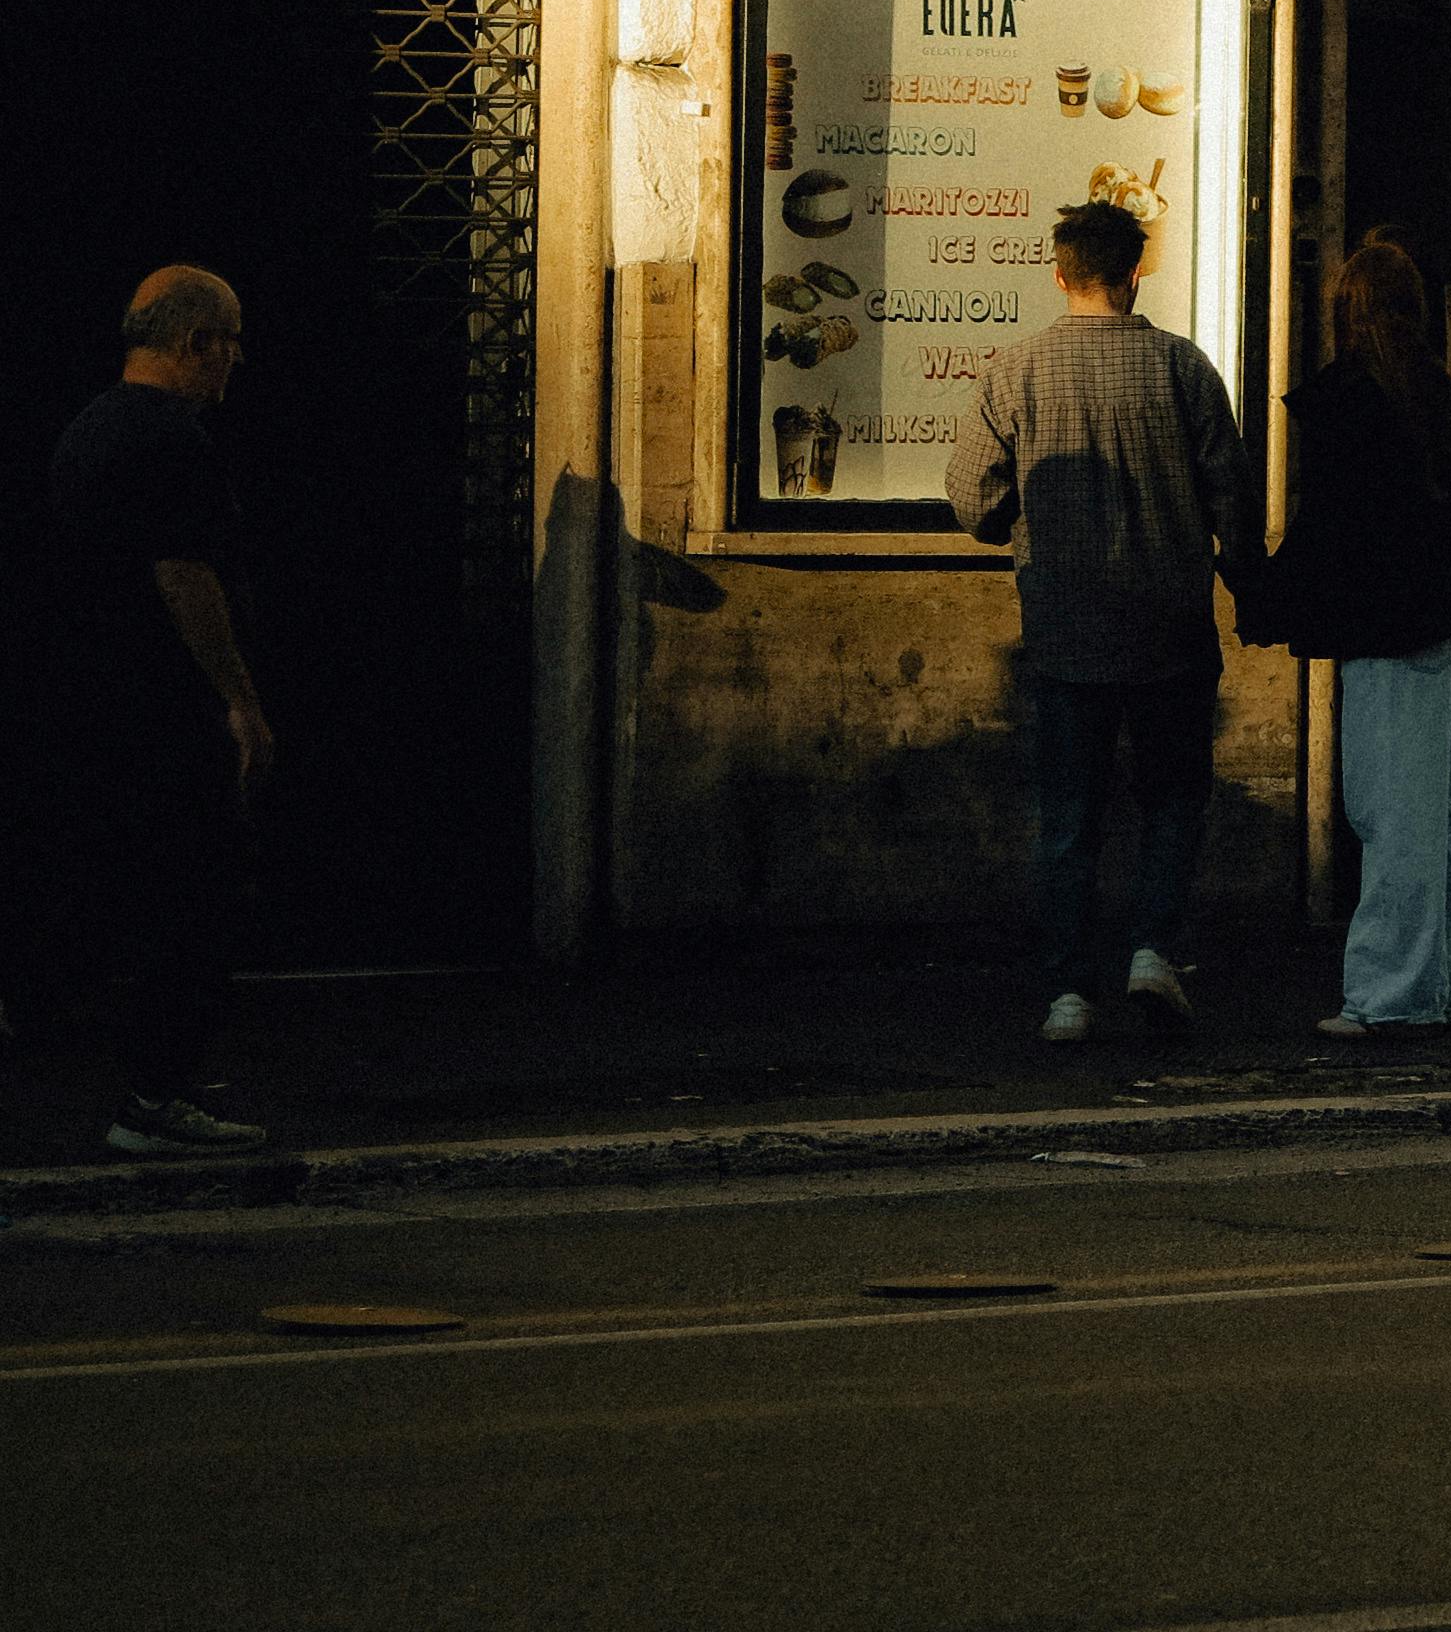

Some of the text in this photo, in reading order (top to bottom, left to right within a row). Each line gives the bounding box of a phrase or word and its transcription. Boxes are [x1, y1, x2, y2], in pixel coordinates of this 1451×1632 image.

[861, 74, 1033, 106] BREAKFAST
[814, 123, 977, 157] MACARON
[865, 185, 1031, 217] MARITOZZI
[928, 234, 976, 264] ICE
[864, 288, 1019, 324] CANNOLI
